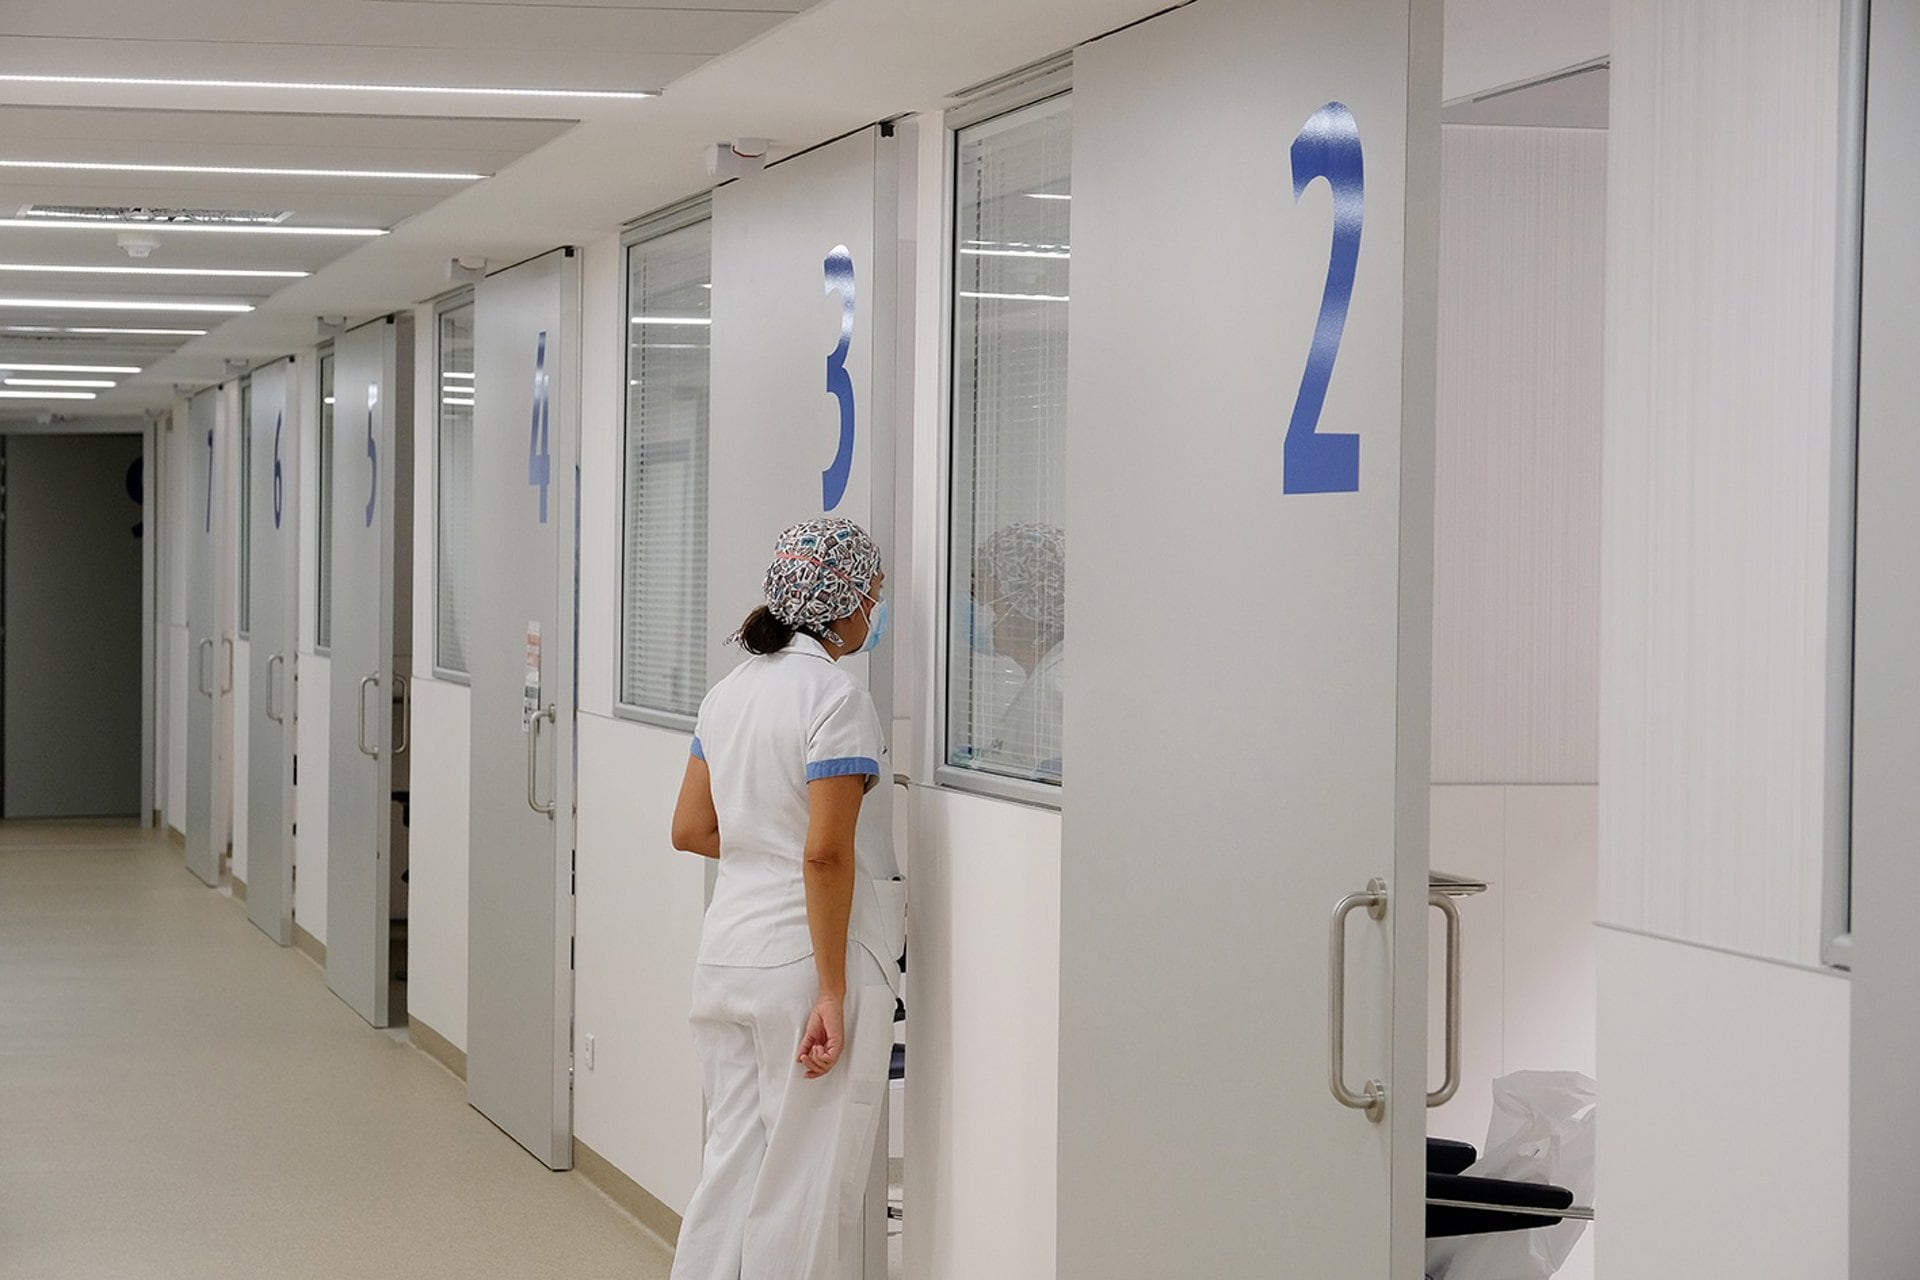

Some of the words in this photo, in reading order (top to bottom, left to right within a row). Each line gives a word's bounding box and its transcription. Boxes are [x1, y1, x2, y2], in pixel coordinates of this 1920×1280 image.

[822, 244, 855, 512] 3
[1283, 101, 1364, 495] 2
[274, 410, 282, 530] 6
[366, 382, 378, 528] 5
[529, 331, 550, 524] 4
